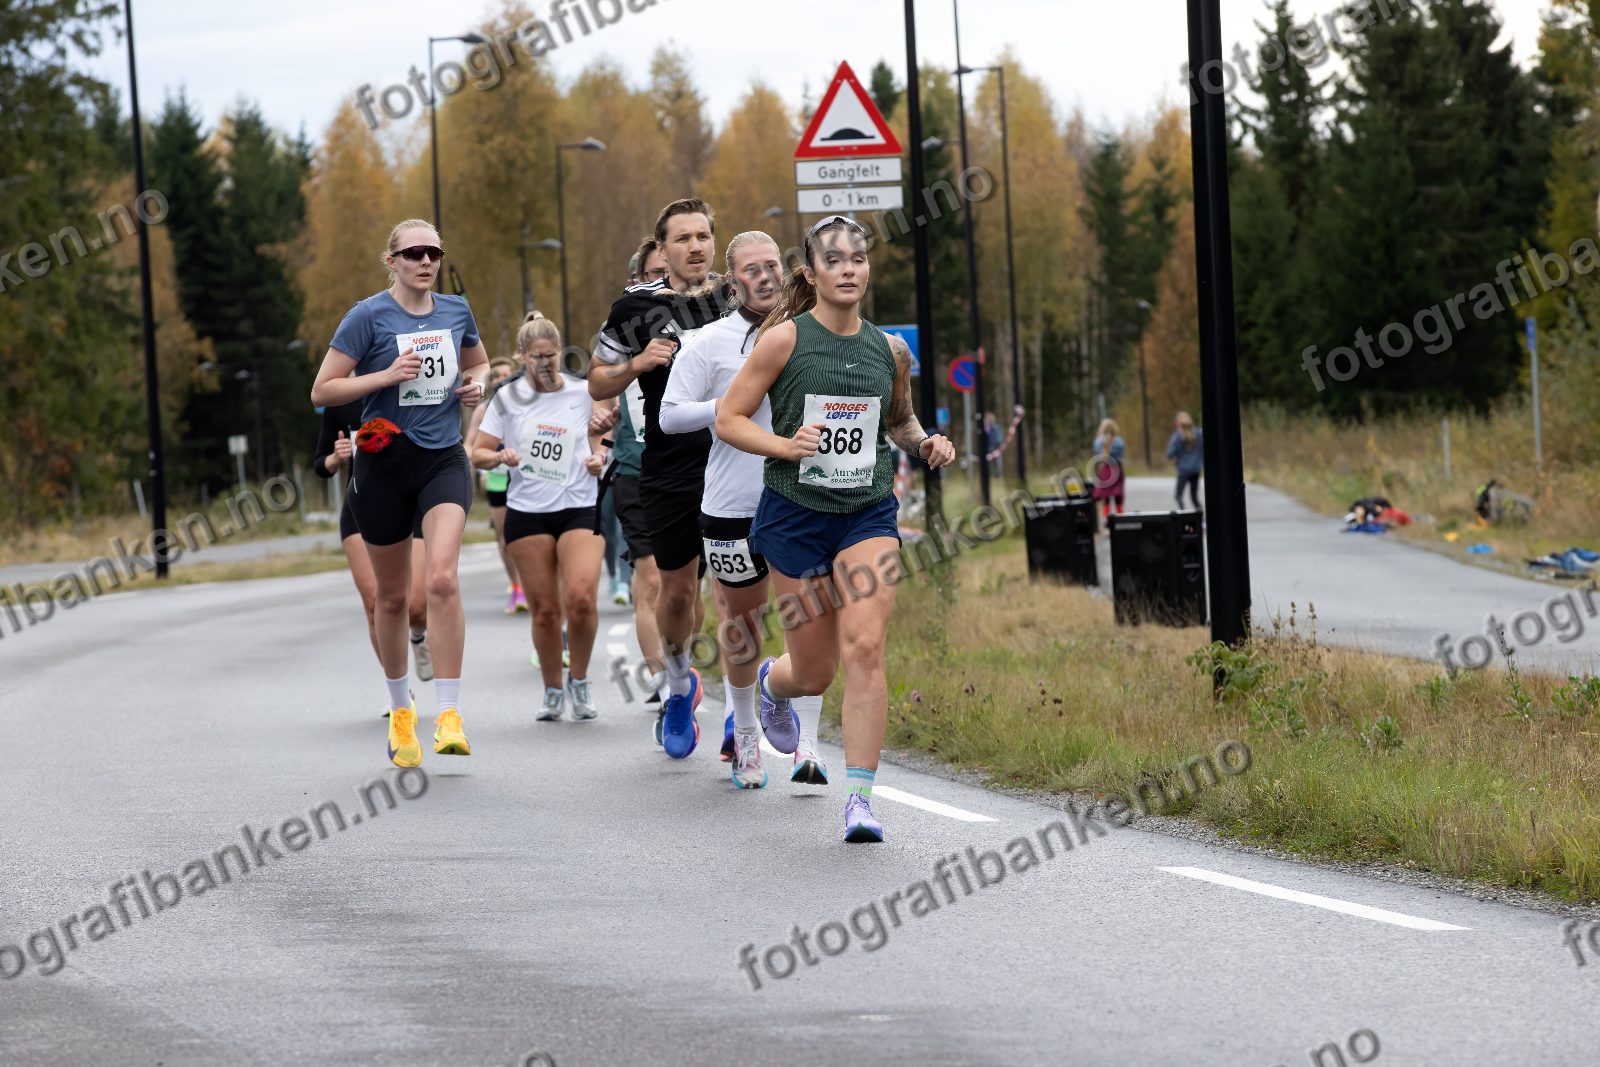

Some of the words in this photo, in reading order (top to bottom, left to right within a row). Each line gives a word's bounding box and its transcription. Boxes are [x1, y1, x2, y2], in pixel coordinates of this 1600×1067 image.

[818, 164, 880, 180] Gangfelt
[822, 193, 832, 207] 0
[847, 193, 853, 206] 1
[858, 192, 879, 205] km
[412, 336, 443, 345] NORGES
[416, 355, 445, 378] 31
[823, 403, 868, 412] NORGES
[825, 411, 860, 420] LØPET
[536, 423, 568, 434] NORGES
[817, 427, 863, 455] 368
[530, 440, 563, 462] 509
[831, 467, 872, 479] Aurskog
[710, 540, 737, 548] LØPET
[709, 552, 747, 574] 653
